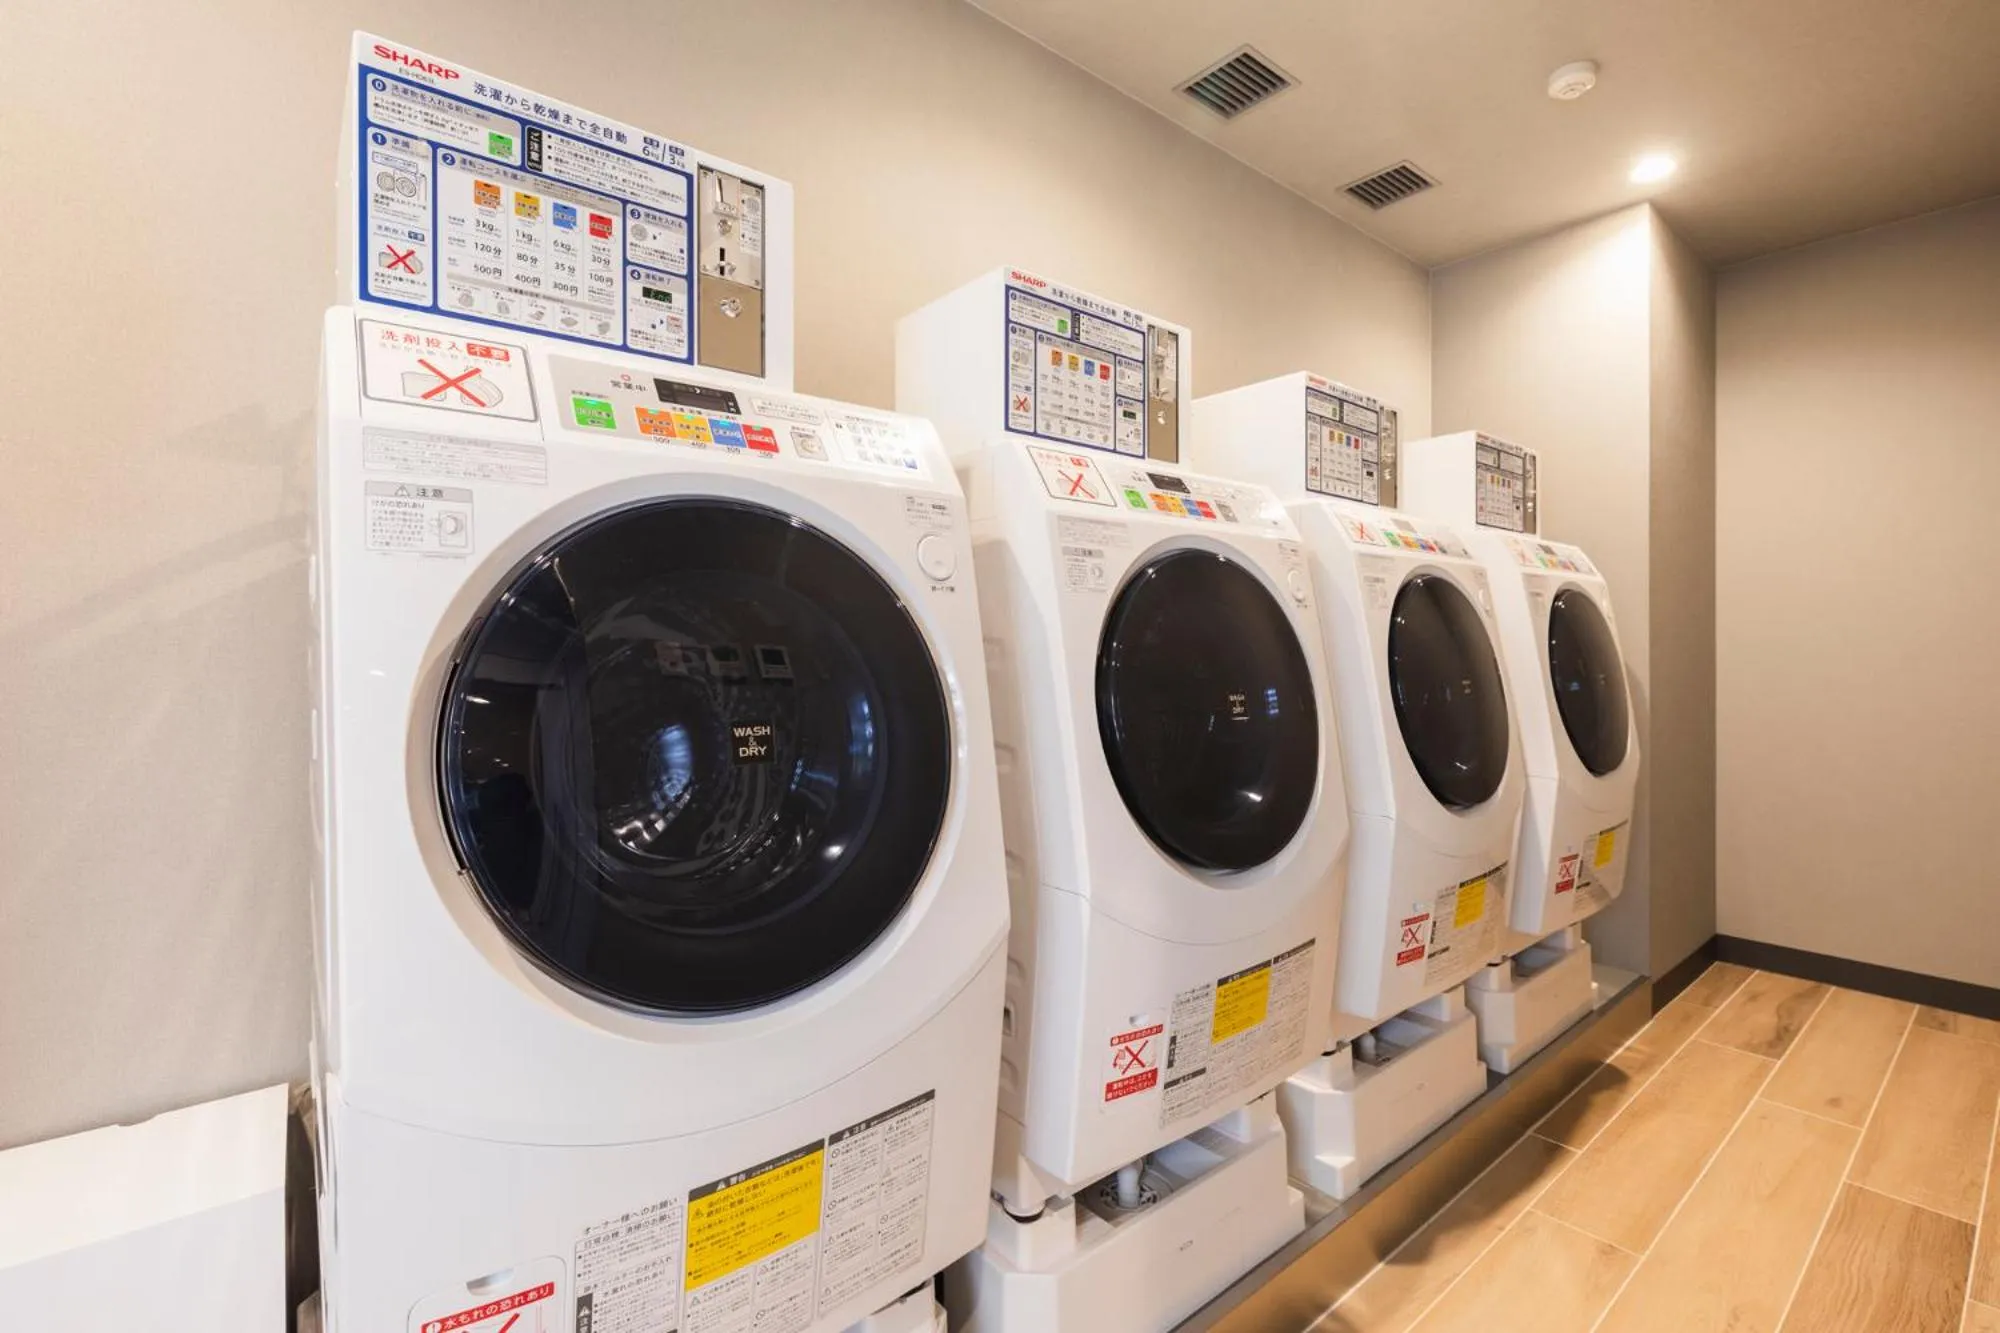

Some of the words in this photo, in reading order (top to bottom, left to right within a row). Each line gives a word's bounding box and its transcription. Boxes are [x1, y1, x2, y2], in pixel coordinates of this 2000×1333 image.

[374, 45, 460, 80] SHARP
[473, 80, 628, 145] 洗濯から乾燥まで全自動
[1011, 271, 1047, 289] SHARP
[733, 726, 771, 737] WASH
[739, 746, 767, 758] DRY
[443, 1285, 551, 1330] 水もれの恐れあり
